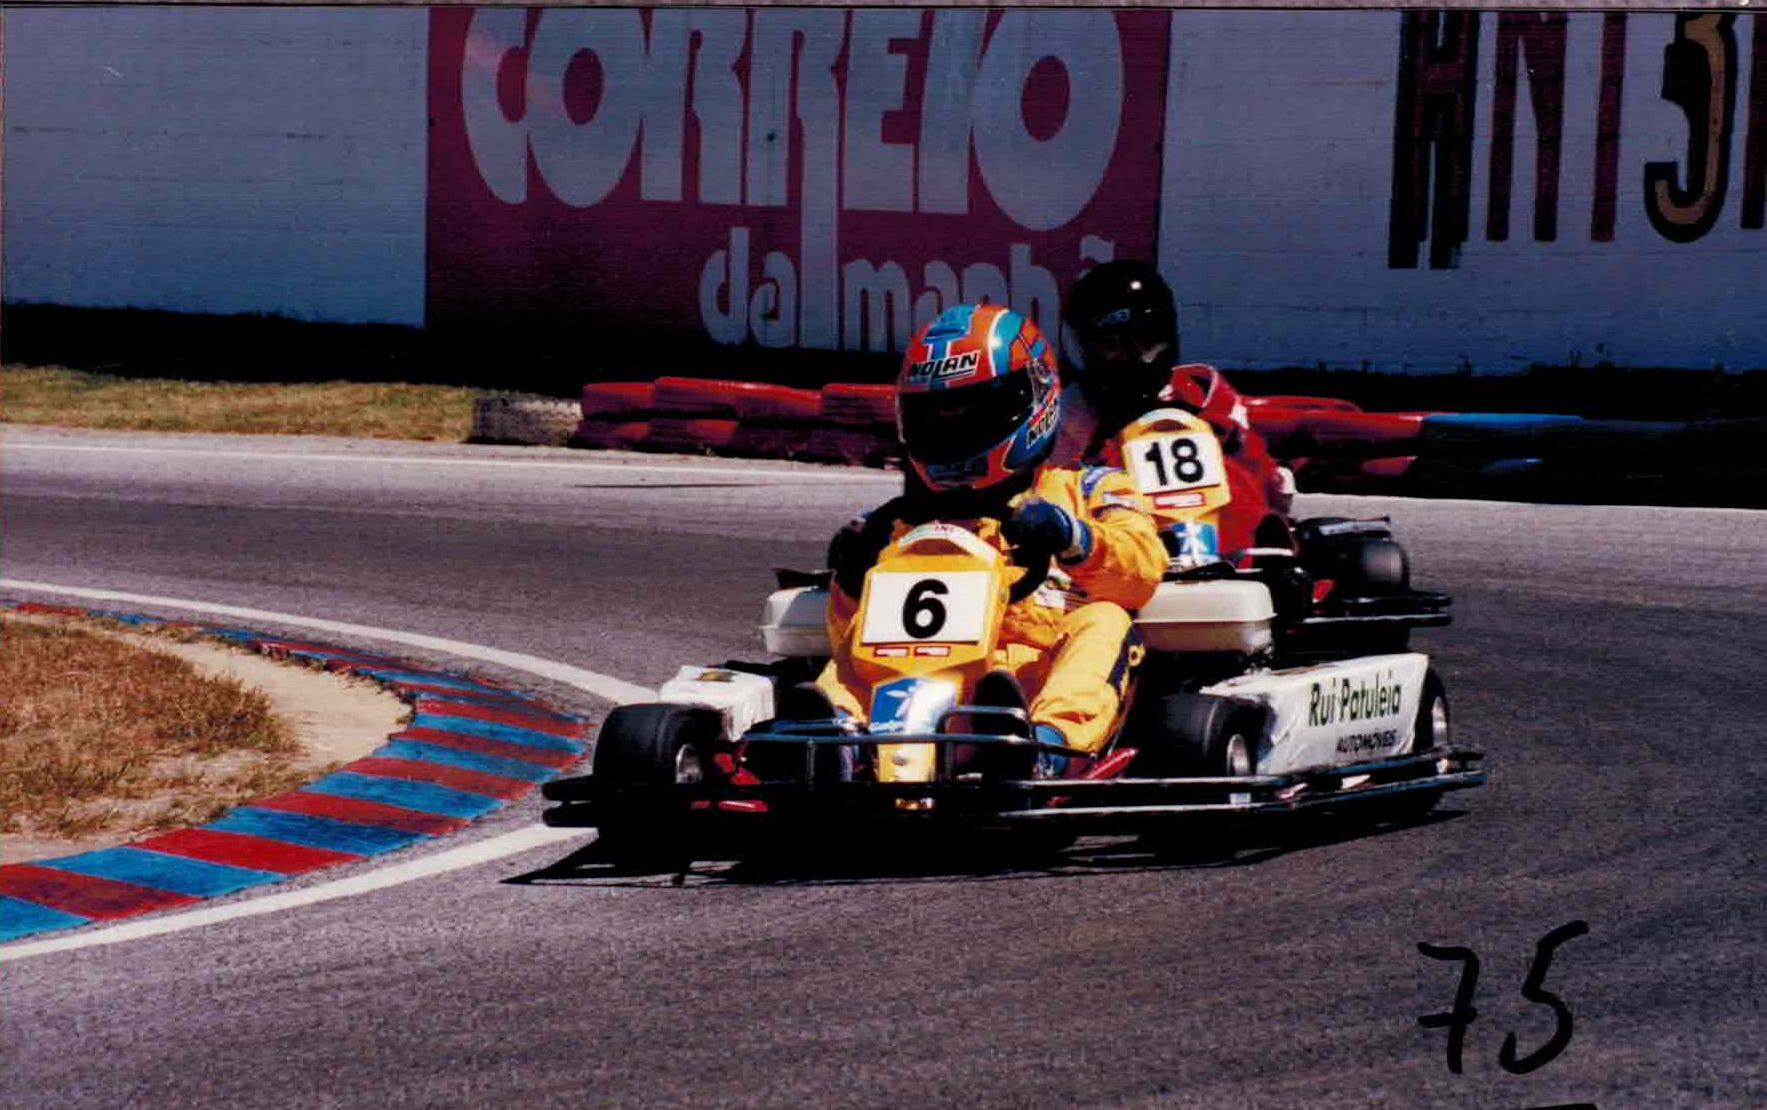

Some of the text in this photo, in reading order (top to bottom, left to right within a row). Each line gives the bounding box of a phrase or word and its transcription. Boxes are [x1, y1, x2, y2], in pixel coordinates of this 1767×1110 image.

[842, 234, 1116, 351] manh
[908, 351, 981, 379] NOLAN
[1145, 438, 1204, 486] 18
[902, 579, 949, 639] 6
[1308, 676, 1336, 727] Rui
[1417, 919, 1589, 1076] 75
